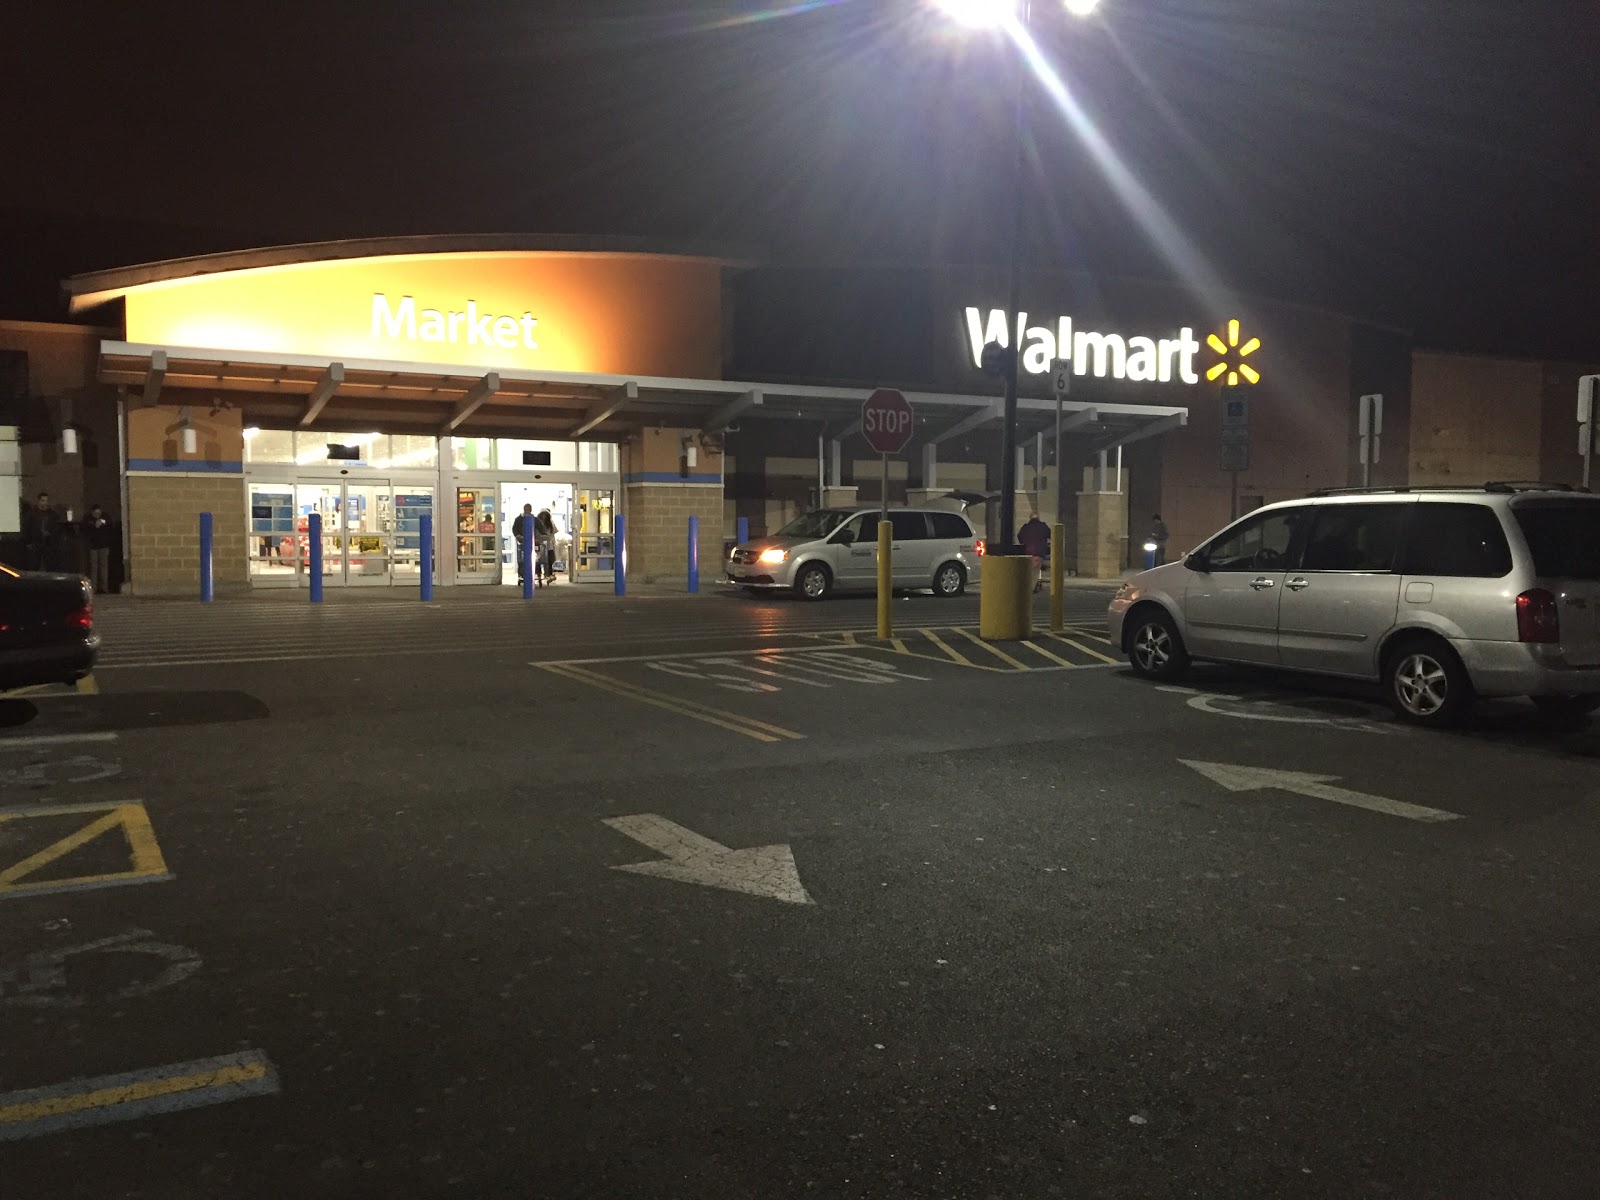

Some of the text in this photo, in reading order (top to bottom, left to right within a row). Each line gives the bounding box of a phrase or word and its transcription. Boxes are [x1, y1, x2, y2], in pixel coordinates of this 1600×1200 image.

[371, 292, 538, 349] Market
[965, 306, 1199, 384] Walmart
[1057, 373, 1065, 390] 6
[866, 408, 909, 433] STOP
[646, 653, 933, 692] STOP
